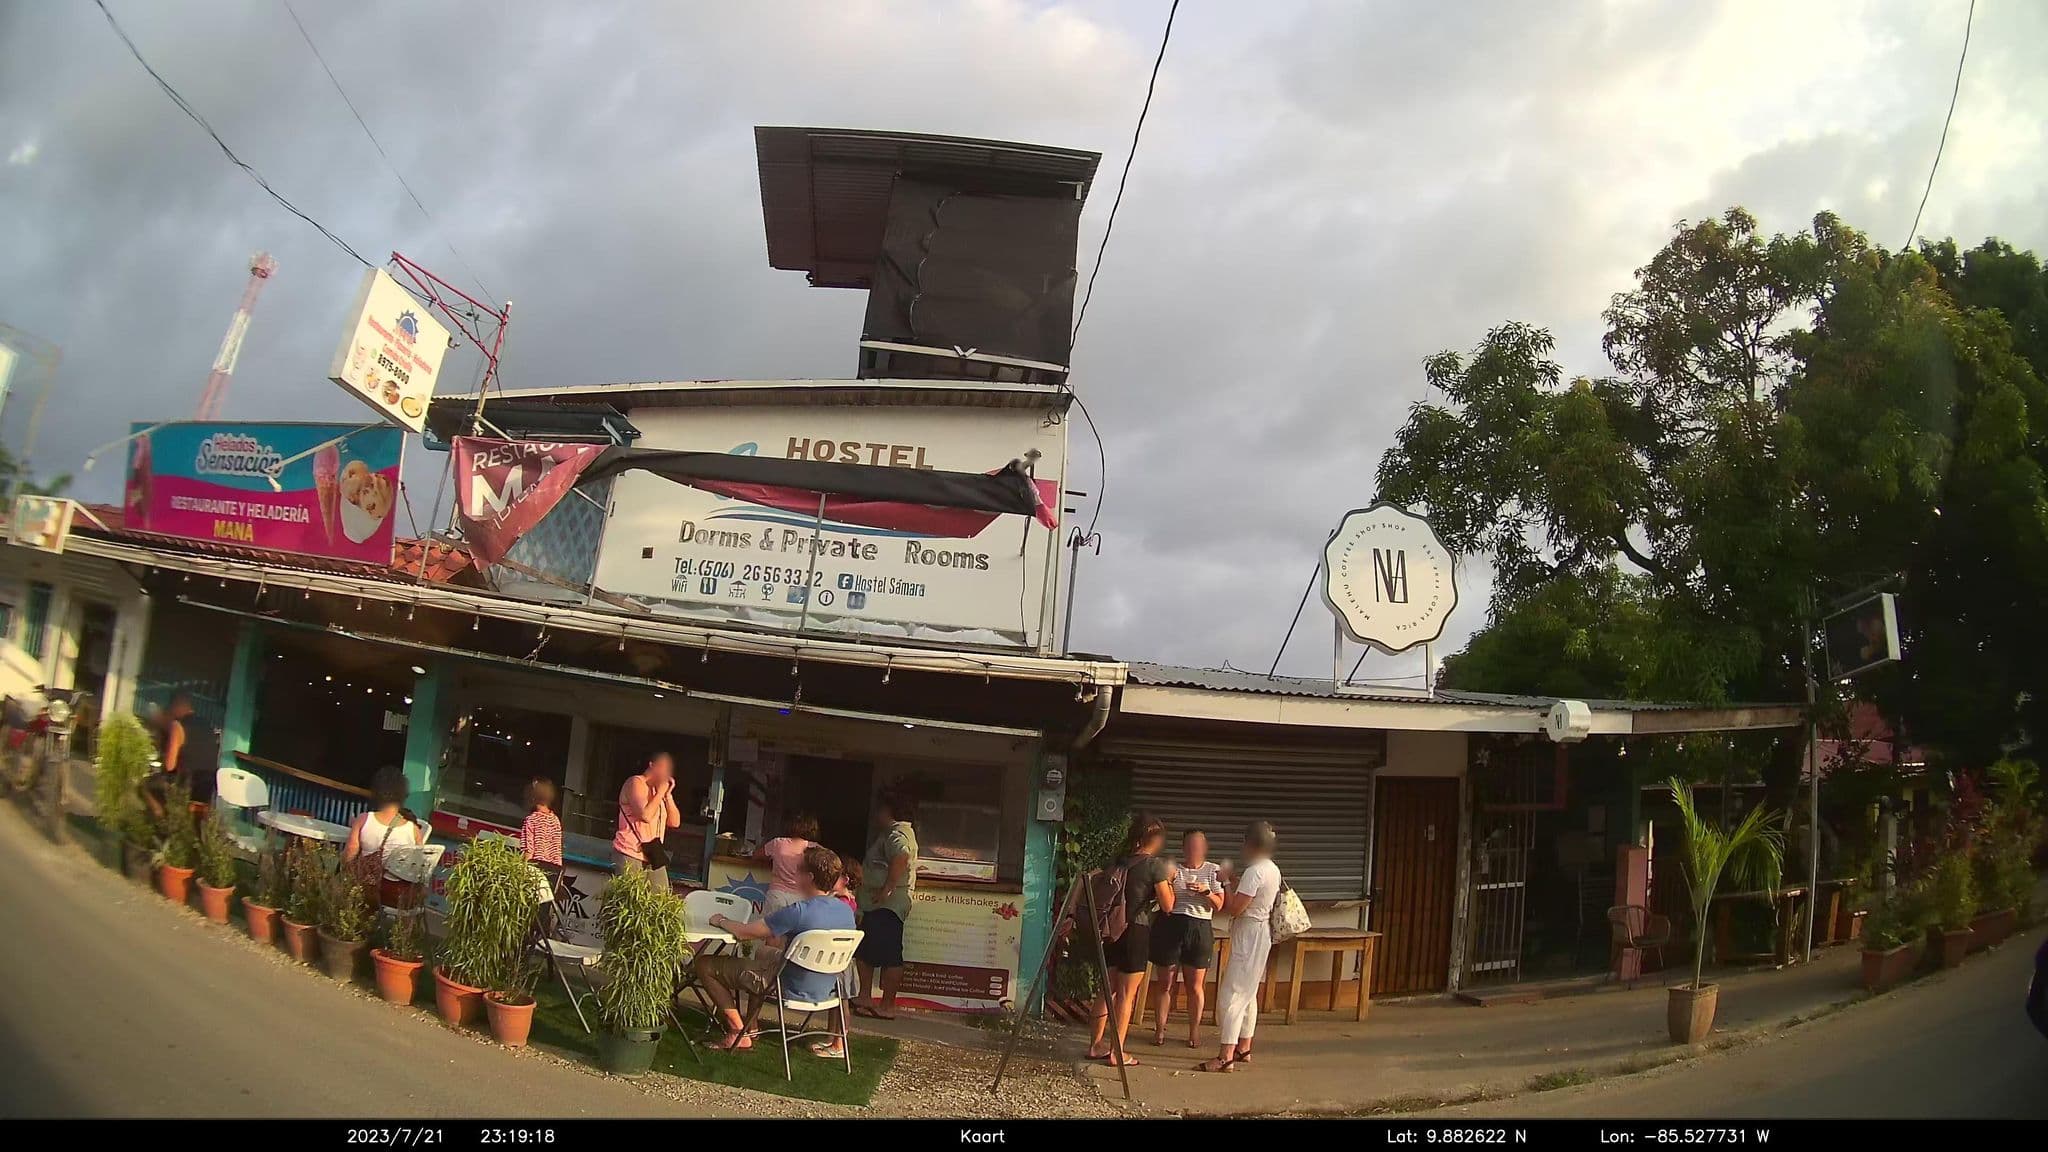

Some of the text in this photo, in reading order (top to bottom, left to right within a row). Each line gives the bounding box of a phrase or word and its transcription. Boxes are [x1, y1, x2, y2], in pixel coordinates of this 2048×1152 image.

[215, 435, 256, 453] Helados
[786, 437, 934, 470] HOSTEL
[171, 495, 310, 524] RESTAURANTE Y HELADERÍA
[679, 520, 990, 571] Dorms & Private Rooms
[855, 574, 886, 593] Hostel
[889, 577, 926, 597] Sámara
[945, 895, 999, 907] Milkshakes
